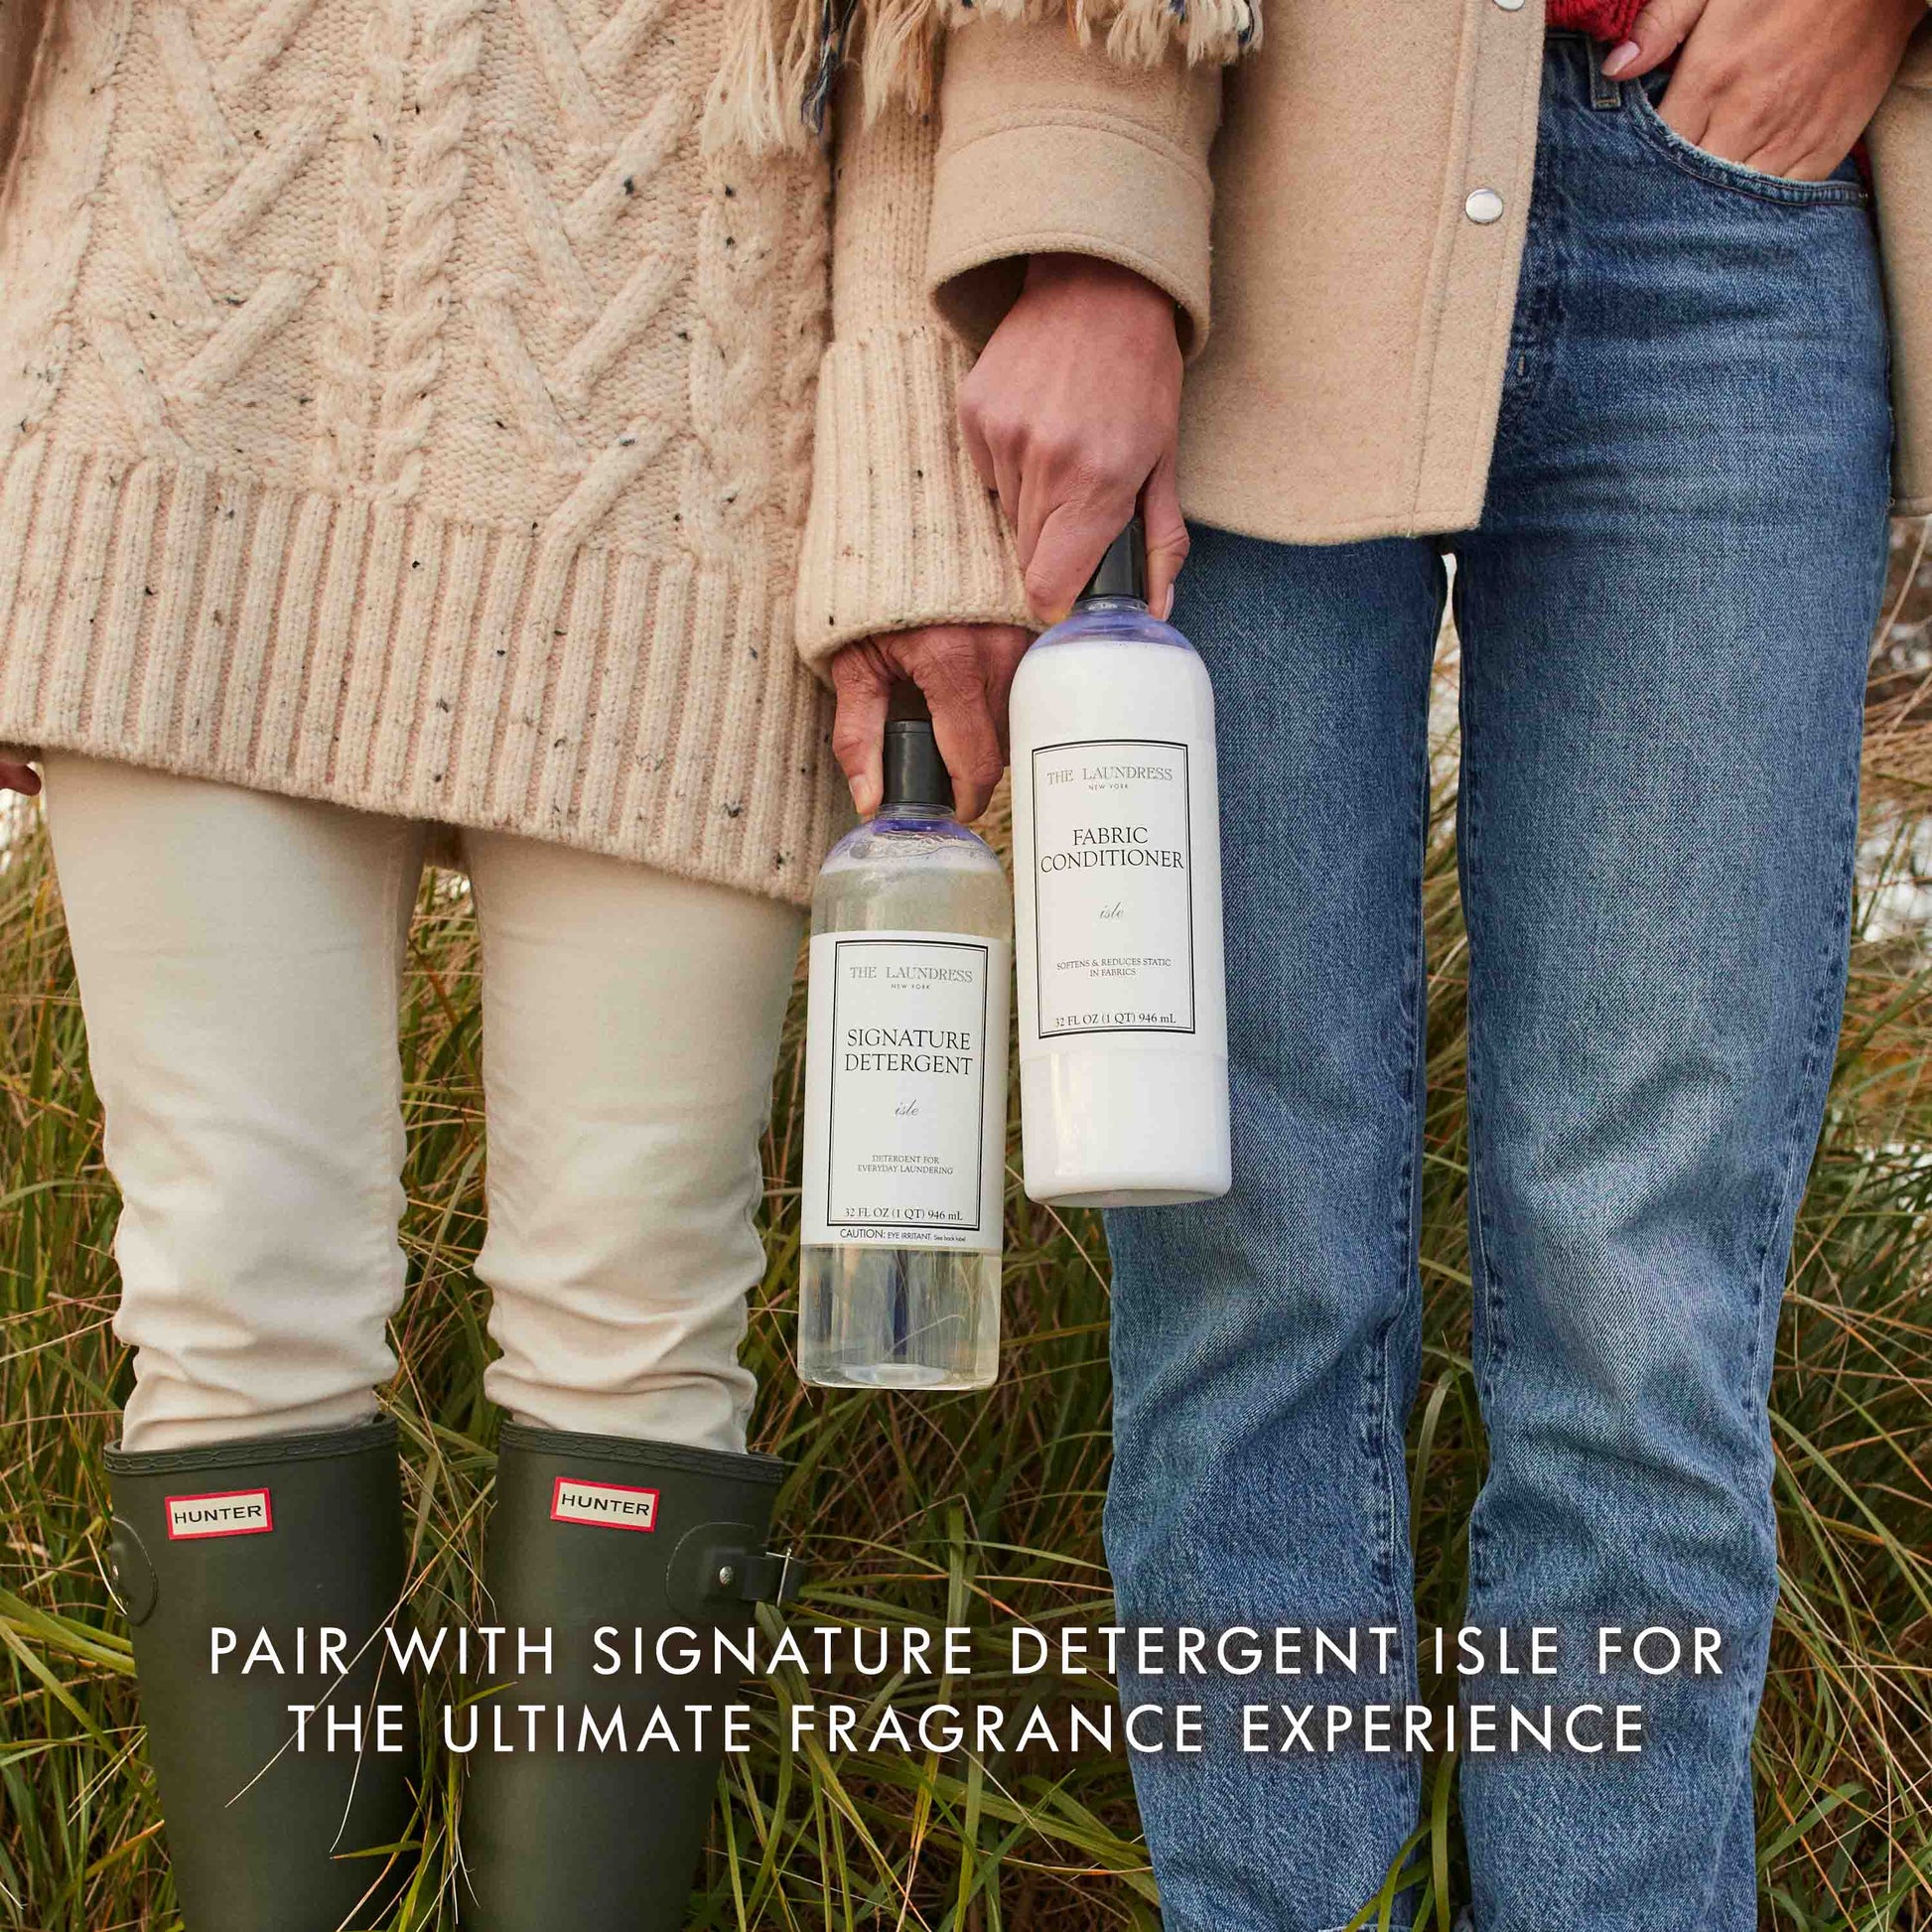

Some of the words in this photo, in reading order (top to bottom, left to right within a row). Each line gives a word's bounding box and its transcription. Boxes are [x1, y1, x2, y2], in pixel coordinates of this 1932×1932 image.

[1047, 769, 1073, 785] THE
[1083, 766, 1173, 781] LAUNDRESS
[1073, 827, 1149, 846] FABRIC
[1040, 849, 1184, 873] CONDITIONER
[1099, 901, 1125, 919] isle
[1056, 959, 1091, 971] SOFTENS
[1101, 957, 1141, 966] REDUCES
[1143, 958, 1172, 967] STATIC
[1101, 968, 1137, 977] FABRICS
[850, 966, 877, 979] THE
[887, 966, 973, 983] LAUNDRESS
[1055, 1018, 1065, 1028] 32
[1067, 1016, 1081, 1026] FL
[1082, 1014, 1099, 1025] OZ
[1101, 1013, 1110, 1025] (1
[1114, 1013, 1136, 1025] QT)
[1139, 1013, 1158, 1024] 946
[1160, 1014, 1176, 1024] mL
[847, 1029, 971, 1050] SIGNATURE
[845, 1053, 973, 1075] DETERGENT
[895, 1099, 920, 1116] isle
[872, 1155, 921, 1164] DETERGENT
[923, 1156, 939, 1165] FOR
[899, 1166, 954, 1174] LAUNDERING
[845, 1208, 855, 1217] 32
[858, 1208, 870, 1217] FL
[874, 1208, 890, 1218] OZ
[892, 1208, 900, 1219] (1
[903, 1208, 925, 1221] QT)
[927, 1210, 946, 1220] 946
[948, 1211, 963, 1221] mL
[840, 1229, 886, 1239] CAUTION:
[562, 1493, 650, 1516] HUNTER
[174, 1505, 262, 1524] HUNTER
